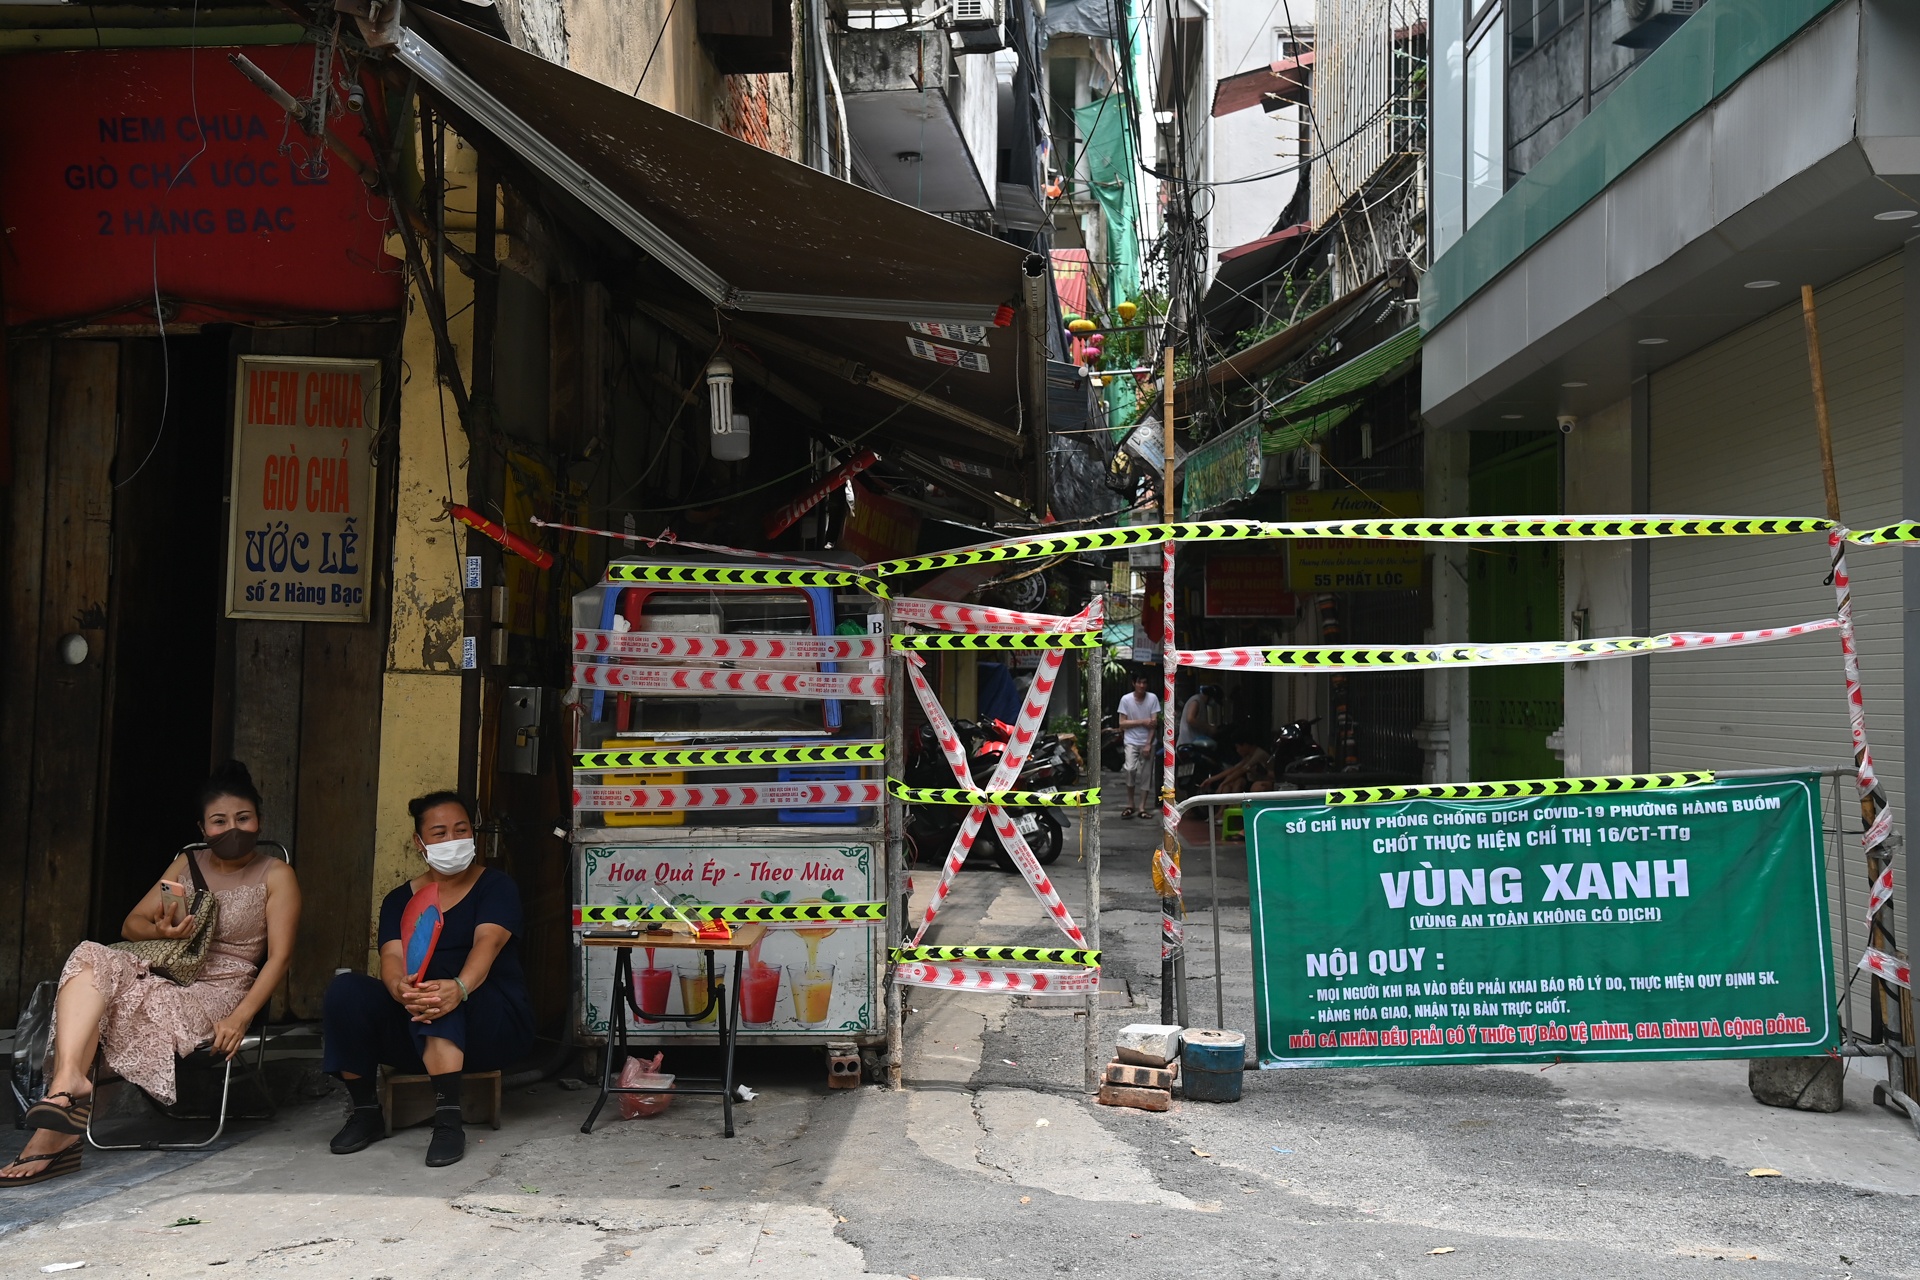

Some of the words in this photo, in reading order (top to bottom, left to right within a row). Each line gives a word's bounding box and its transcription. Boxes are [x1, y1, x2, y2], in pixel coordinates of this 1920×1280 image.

[98, 116, 165, 143] NEM
[176, 114, 270, 142] CHUA
[64, 156, 118, 191] GIÒ
[97, 210, 114, 236] 2
[248, 370, 299, 426] NEM
[304, 371, 363, 428] CHUA
[263, 443, 300, 512] GIÒ
[306, 437, 350, 514] CHẢ
[245, 521, 310, 574] ƯỚC
[318, 516, 359, 575] LỄ
[246, 579, 267, 602] số
[270, 583, 280, 602] 2
[285, 581, 326, 606] Hàng
[331, 583, 363, 608] Bạc
[1314, 574, 1331, 587] 55
[1336, 569, 1372, 587] PHẤT
[1285, 817, 1307, 834] SỞ
[1310, 815, 1337, 833] CHỈ
[1340, 817, 1371, 831] HUY
[1375, 809, 1429, 829] PHÒNG
[1433, 805, 1486, 826] CHỐNG
[1488, 808, 1529, 825] DỊCH
[1533, 805, 1605, 821] COVID-19
[1609, 801, 1678, 818] PHƯỜNG
[1682, 799, 1728, 815] HÀNG
[1731, 794, 1781, 812] BUỒM
[1372, 831, 1419, 854] CHỐT
[1422, 833, 1472, 854] THỰC
[1476, 829, 1521, 852] HIỆN
[1526, 826, 1557, 847] CHỈ
[1561, 827, 1592, 847] THỊ
[1597, 824, 1691, 843] 16/CT-TTg
[608, 862, 646, 882] Hoa
[654, 862, 693, 886] Quả
[701, 858, 726, 886] Ép
[750, 861, 793, 881] Theo
[800, 861, 845, 882] Mùa
[1379, 861, 1523, 909] VÙNG
[1539, 858, 1690, 902] XANH
[1409, 912, 1457, 931] (VÙNG
[1461, 913, 1484, 929] AN
[1487, 909, 1529, 929] TOÀN
[1532, 907, 1587, 927] KHÔNG
[1591, 906, 1613, 924] CÓ
[1617, 906, 1662, 924] DỊCH)
[1305, 947, 1359, 981] NỘI
[1368, 946, 1426, 977] QUY
[1342, 983, 1380, 1001] NGƯỜI
[1382, 984, 1403, 999] KHI
[1405, 983, 1422, 997] RA
[1423, 980, 1448, 996] VÀO
[1449, 979, 1474, 995] ĐỀU
[1476, 977, 1506, 995] PHẢI
[1508, 979, 1538, 994] KHAI
[1540, 976, 1565, 994] BÁO
[1567, 975, 1585, 992] RÕ
[1587, 974, 1602, 991] LÝ
[1605, 976, 1627, 992] DO,
[1628, 975, 1662, 993] THỰC
[1664, 972, 1695, 992] HIỆN
[1697, 973, 1722, 990] QUY
[1725, 971, 1756, 990] ĐỊNH
[1758, 970, 1780, 985] 5K.
[1353, 1005, 1378, 1021] HÓA
[1380, 1005, 1412, 1020] GIAO,
[1414, 1001, 1449, 1020] NHẬN
[1450, 1003, 1470, 1019] TẠI
[1472, 1000, 1499, 1017] BÀN
[1500, 1000, 1533, 1018] TRỰC
[1535, 997, 1571, 1015] CHỐT.
[1290, 1030, 1316, 1049] MỖI
[1319, 1031, 1337, 1048] CÁ
[1340, 1028, 1378, 1047] NHÂN
[1381, 1027, 1408, 1047] ĐỀU
[1411, 1027, 1443, 1046] PHẢI
[1446, 1025, 1465, 1045] CÓ
[1467, 1022, 1479, 1044] Ý
[1481, 1025, 1516, 1044] THỨC
[1519, 1023, 1537, 1044] TỰ
[1539, 1023, 1567, 1042] BẢO
[1570, 1022, 1588, 1042] VỆ
[1591, 1022, 1633, 1041] MÌNH,
[1636, 1021, 1661, 1040] GIA
[1663, 1020, 1699, 1039] ĐÌNH
[1702, 1019, 1721, 1038] VÀ
[1724, 1016, 1763, 1038] CỘNG
[1767, 1014, 1809, 1035] ĐỒNG.
